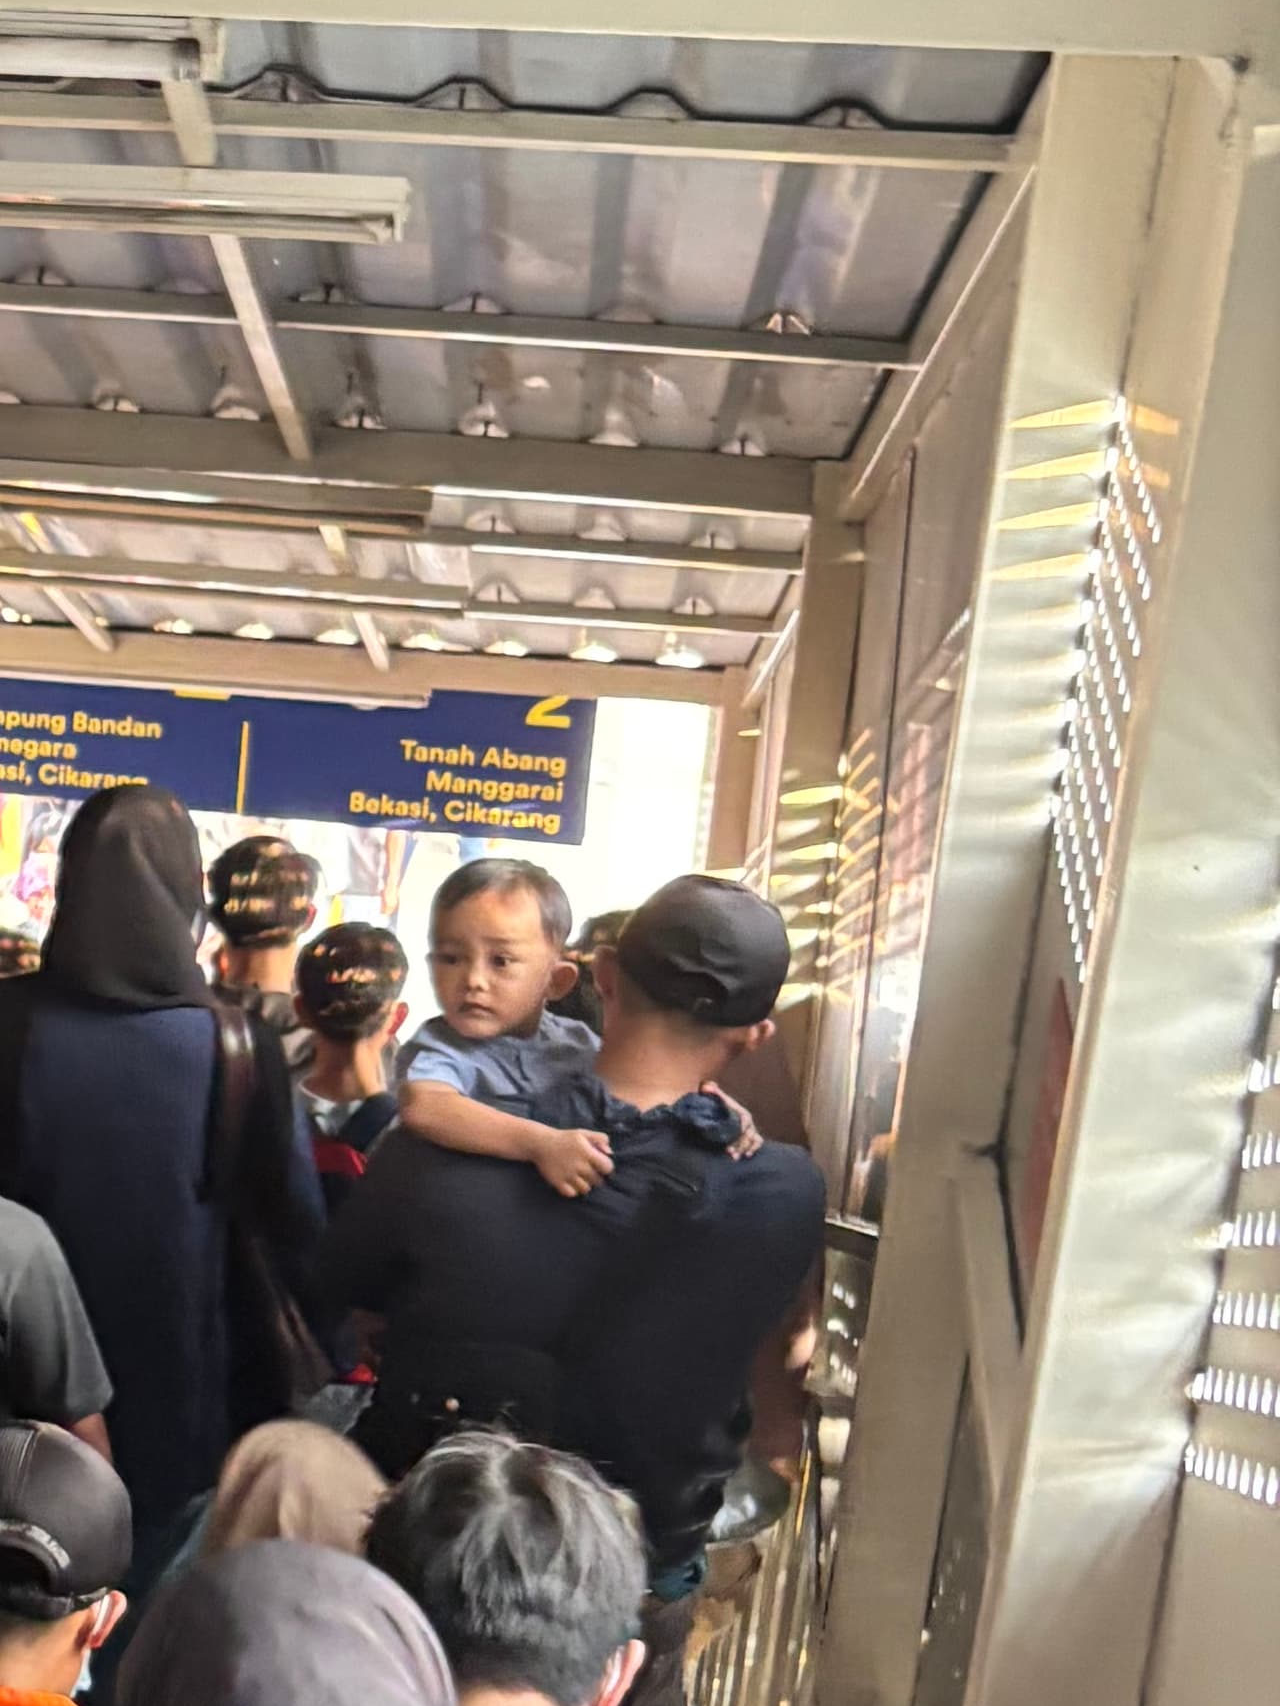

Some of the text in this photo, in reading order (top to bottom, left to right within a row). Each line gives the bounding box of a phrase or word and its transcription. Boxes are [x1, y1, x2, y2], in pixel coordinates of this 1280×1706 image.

[72, 710, 163, 739] Bandan
[399, 738, 567, 778] Tanah Abang
[426, 769, 564, 803] Manggarai
[349, 790, 562, 835] Bekasi, Cikarang
